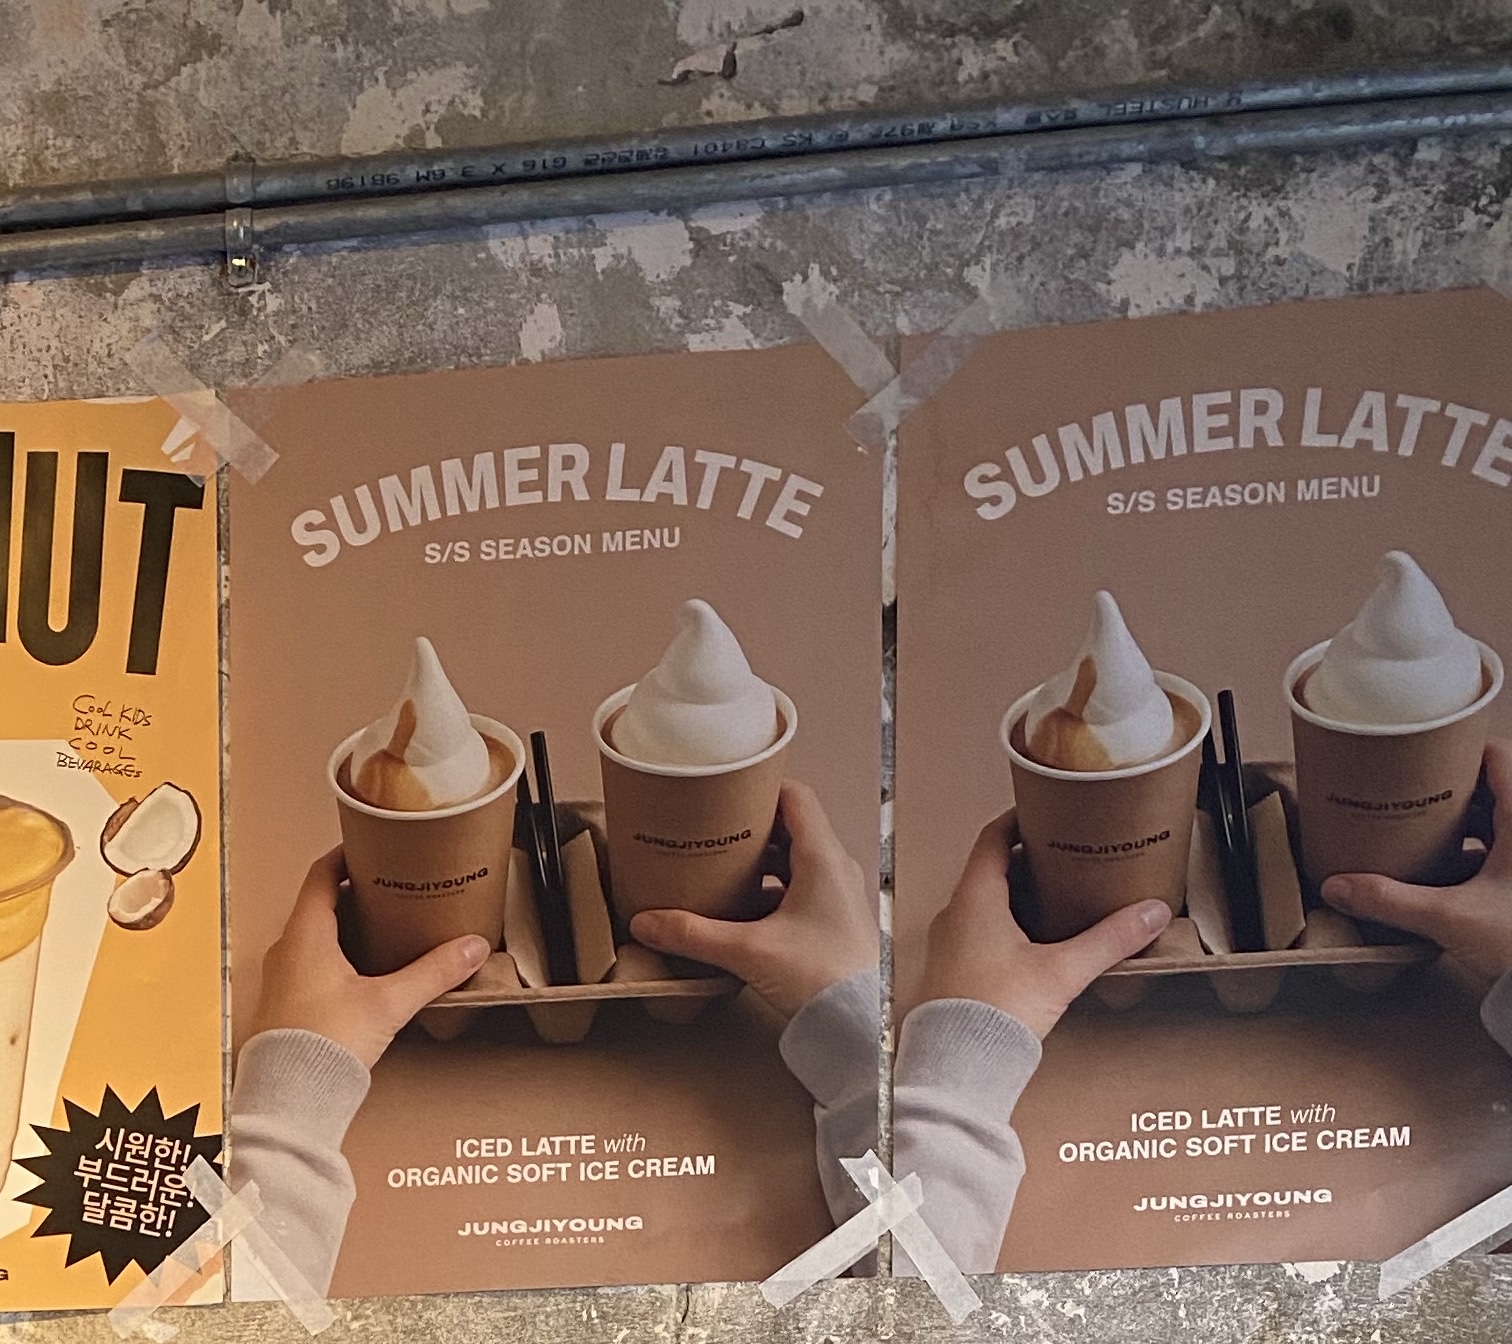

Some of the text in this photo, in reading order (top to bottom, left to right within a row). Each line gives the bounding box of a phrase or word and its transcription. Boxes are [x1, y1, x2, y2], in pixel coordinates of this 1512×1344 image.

[963, 387, 1285, 520] SUMMER
[291, 441, 824, 567] SUMMER LATTE
[1106, 475, 1381, 515] S/S SEASON MENU
[423, 526, 681, 564] S/S SEASON MENU
[74, 716, 133, 742] DRINK
[372, 867, 489, 892] JUNGJIYOUNG
[1130, 1102, 1337, 1133] ICED LATTE with
[95, 1126, 192, 1173] 시원한!
[454, 1131, 648, 1159] ICED LATTE with
[1058, 1126, 1412, 1164] ORGANIC SOFT ICE CREAM
[386, 1155, 716, 1189] ORGANIC SOFT ICE CREAM
[82, 1188, 176, 1239] 달콤한!
[1133, 1189, 1333, 1213] JUNGJIYOUNG
[1174, 1210, 1292, 1223] COFFEE ROASTERS
[457, 1215, 644, 1237] JUNGJIYOUNG
[494, 1235, 606, 1248] COFFEE ROASTERS
